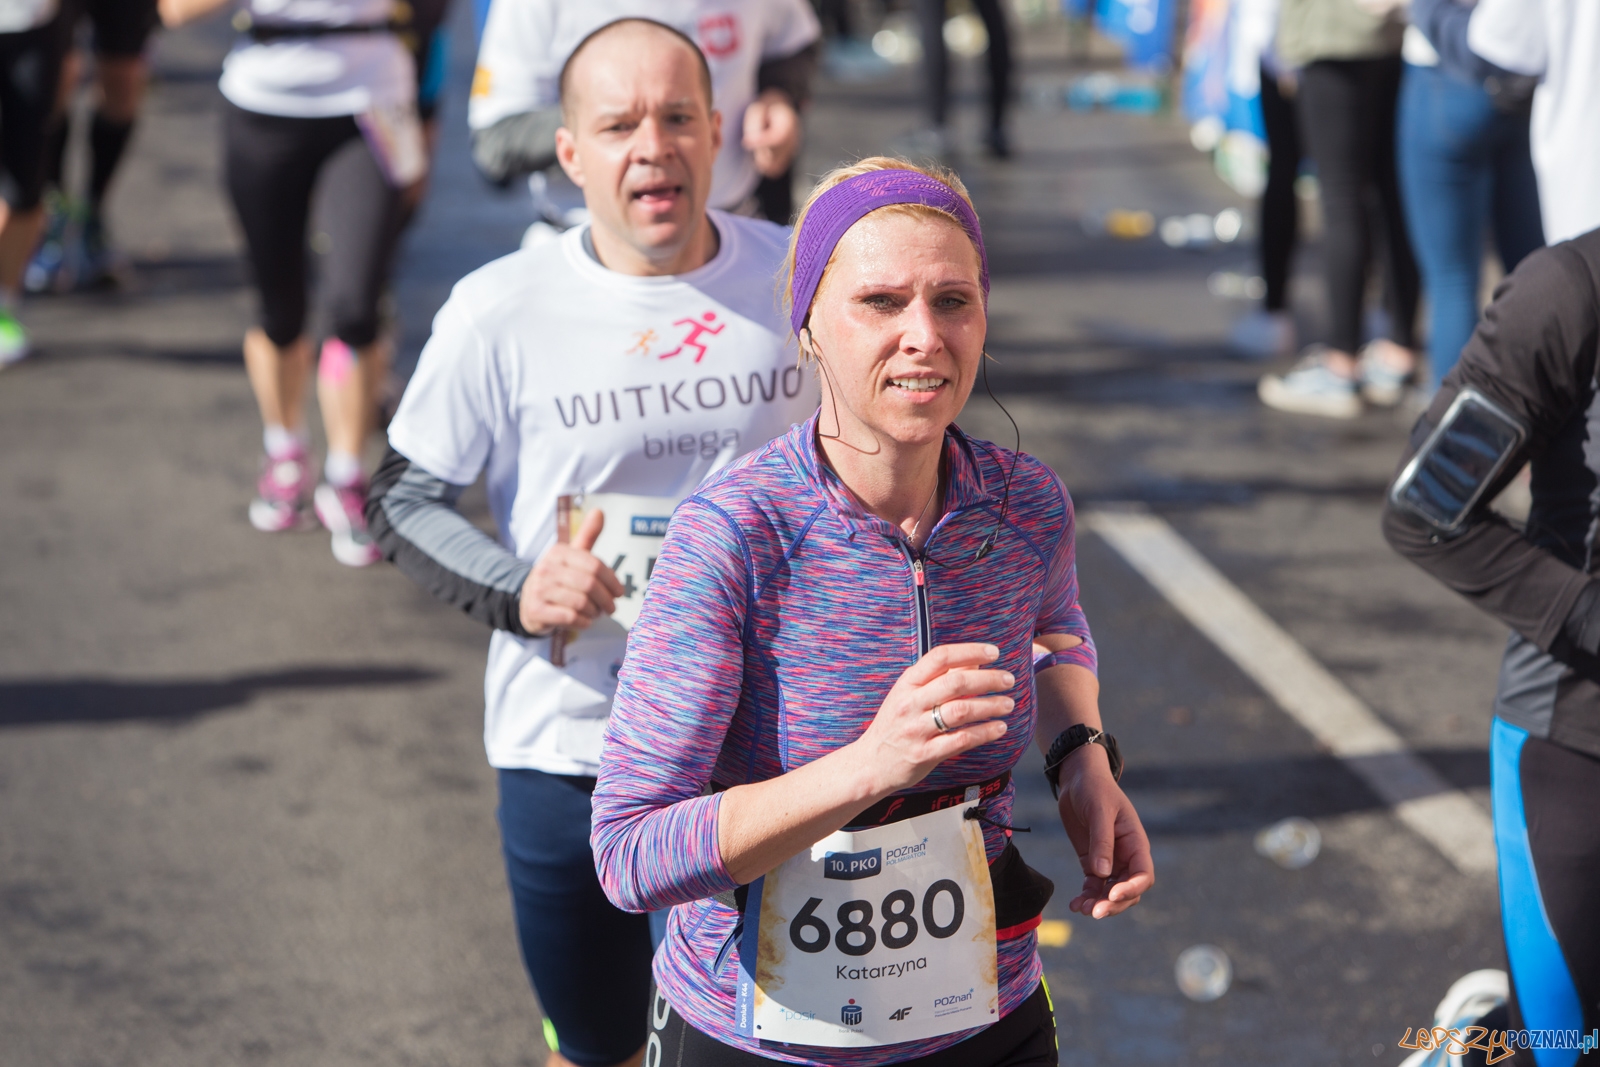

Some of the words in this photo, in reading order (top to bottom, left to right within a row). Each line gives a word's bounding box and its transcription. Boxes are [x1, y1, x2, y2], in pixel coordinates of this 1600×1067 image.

[554, 365, 804, 428] WITKOWO
[643, 427, 741, 460] biega
[830, 860, 848, 872] 10.
[850, 857, 877, 872] PKO
[789, 878, 965, 956] 6880
[836, 956, 927, 980] Katarzyna
[888, 1006, 913, 1021] 4F
